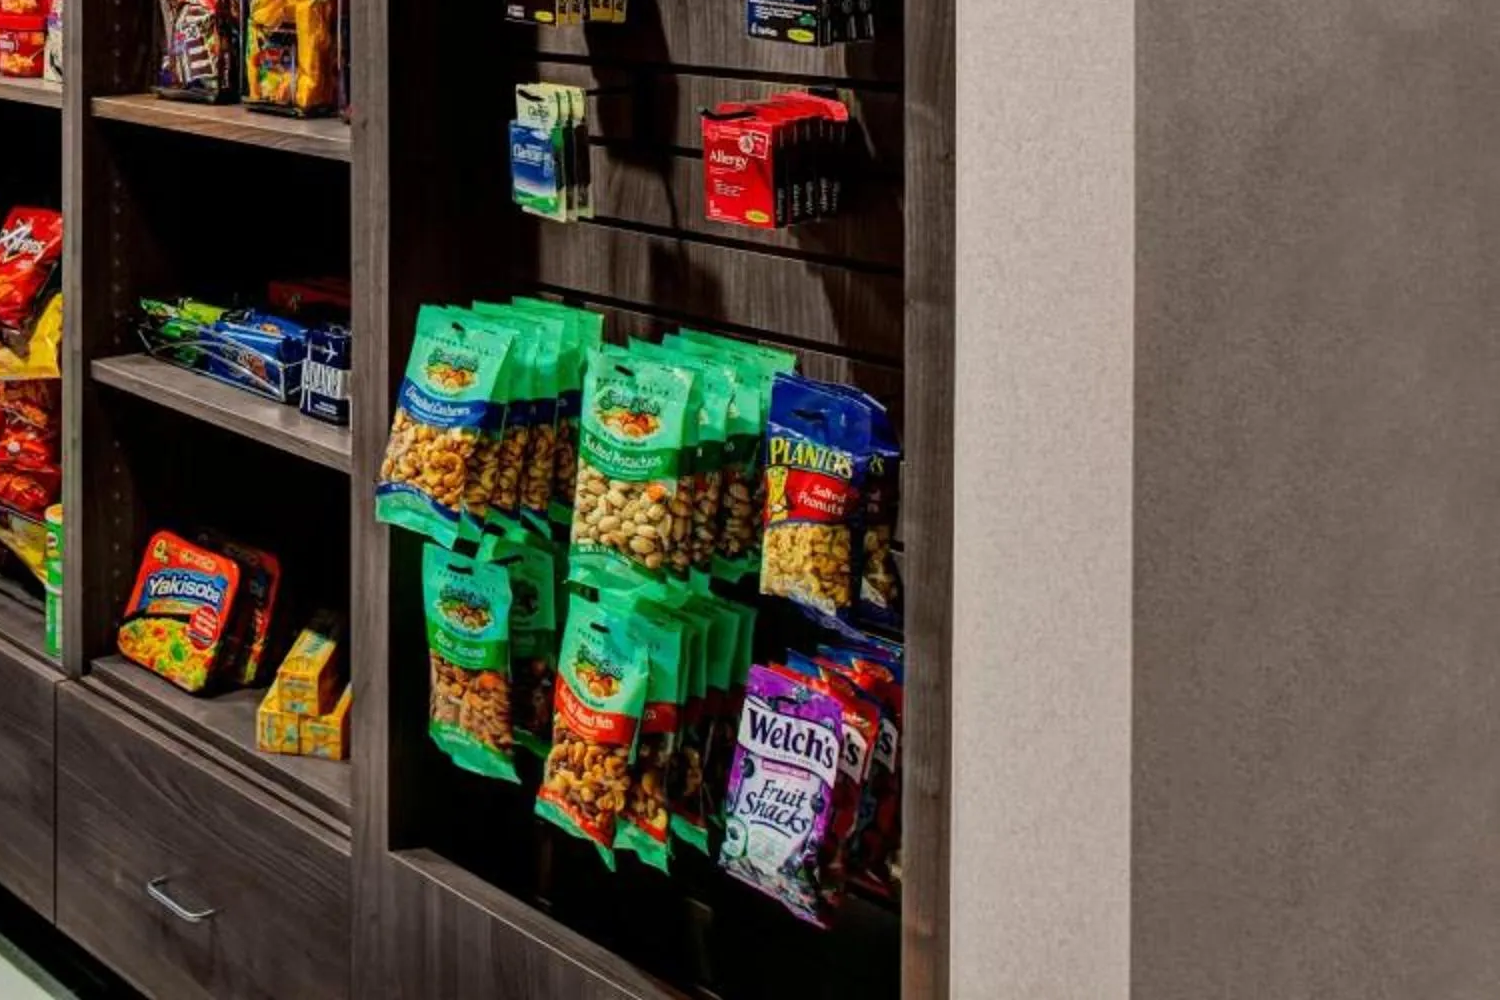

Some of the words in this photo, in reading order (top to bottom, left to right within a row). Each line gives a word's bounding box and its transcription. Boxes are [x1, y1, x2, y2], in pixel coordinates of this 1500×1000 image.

[709, 149, 748, 171] Allergy
[770, 436, 853, 479] PLANTERS
[798, 490, 845, 516] Peanuts
[811, 484, 846, 503] Salted
[149, 575, 221, 604] Yakisoba
[747, 708, 835, 769] Welch's
[759, 779, 809, 809] Fruit
[739, 791, 811, 835] Snacks
